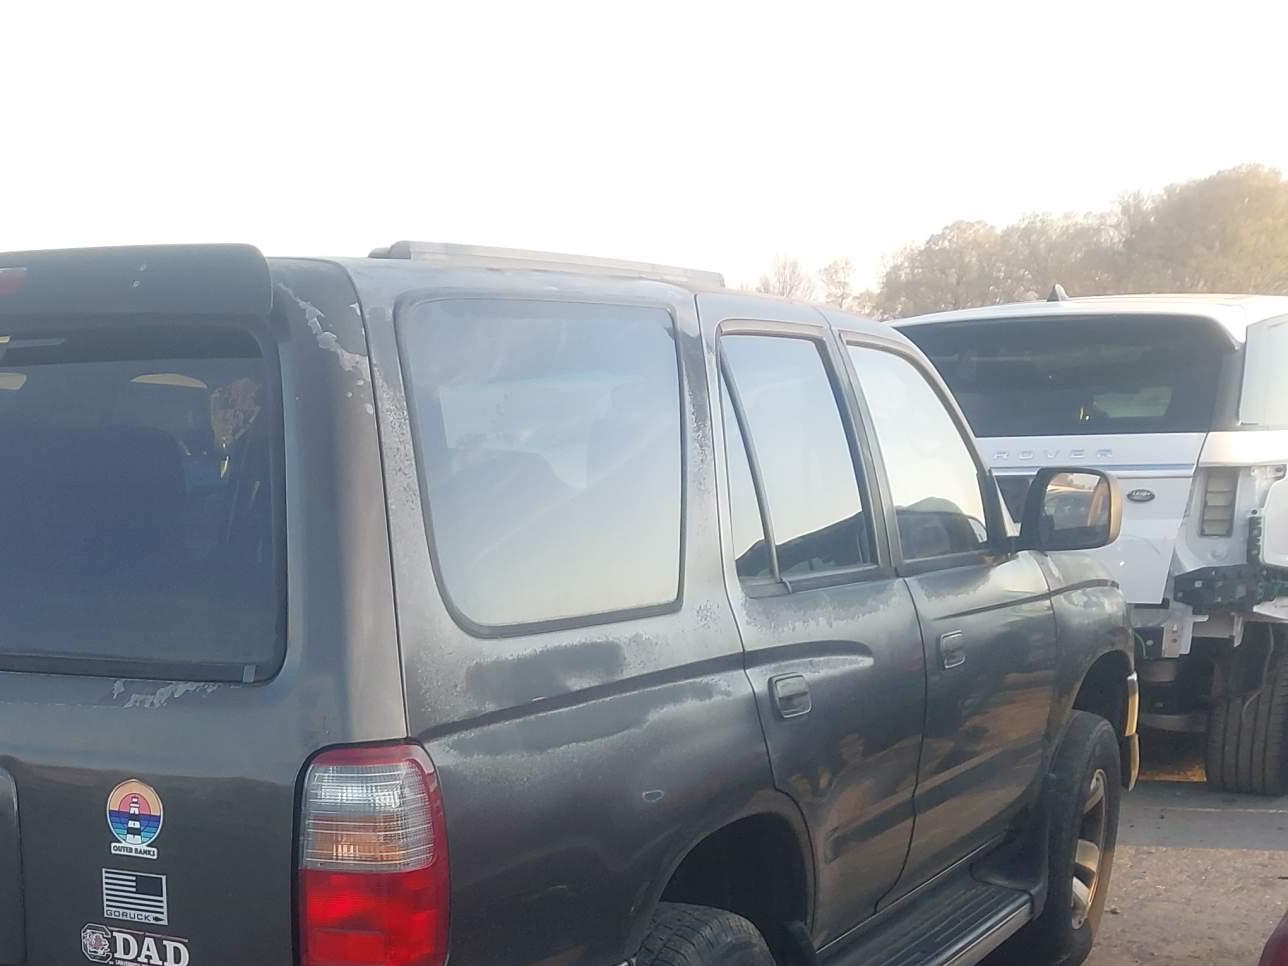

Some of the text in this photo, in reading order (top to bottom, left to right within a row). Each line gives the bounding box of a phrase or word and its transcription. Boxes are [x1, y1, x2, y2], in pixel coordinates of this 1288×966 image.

[992, 449, 1112, 460] ROVER
[112, 845, 156, 857] OUTER BANKS
[105, 909, 152, 922] GORUCK
